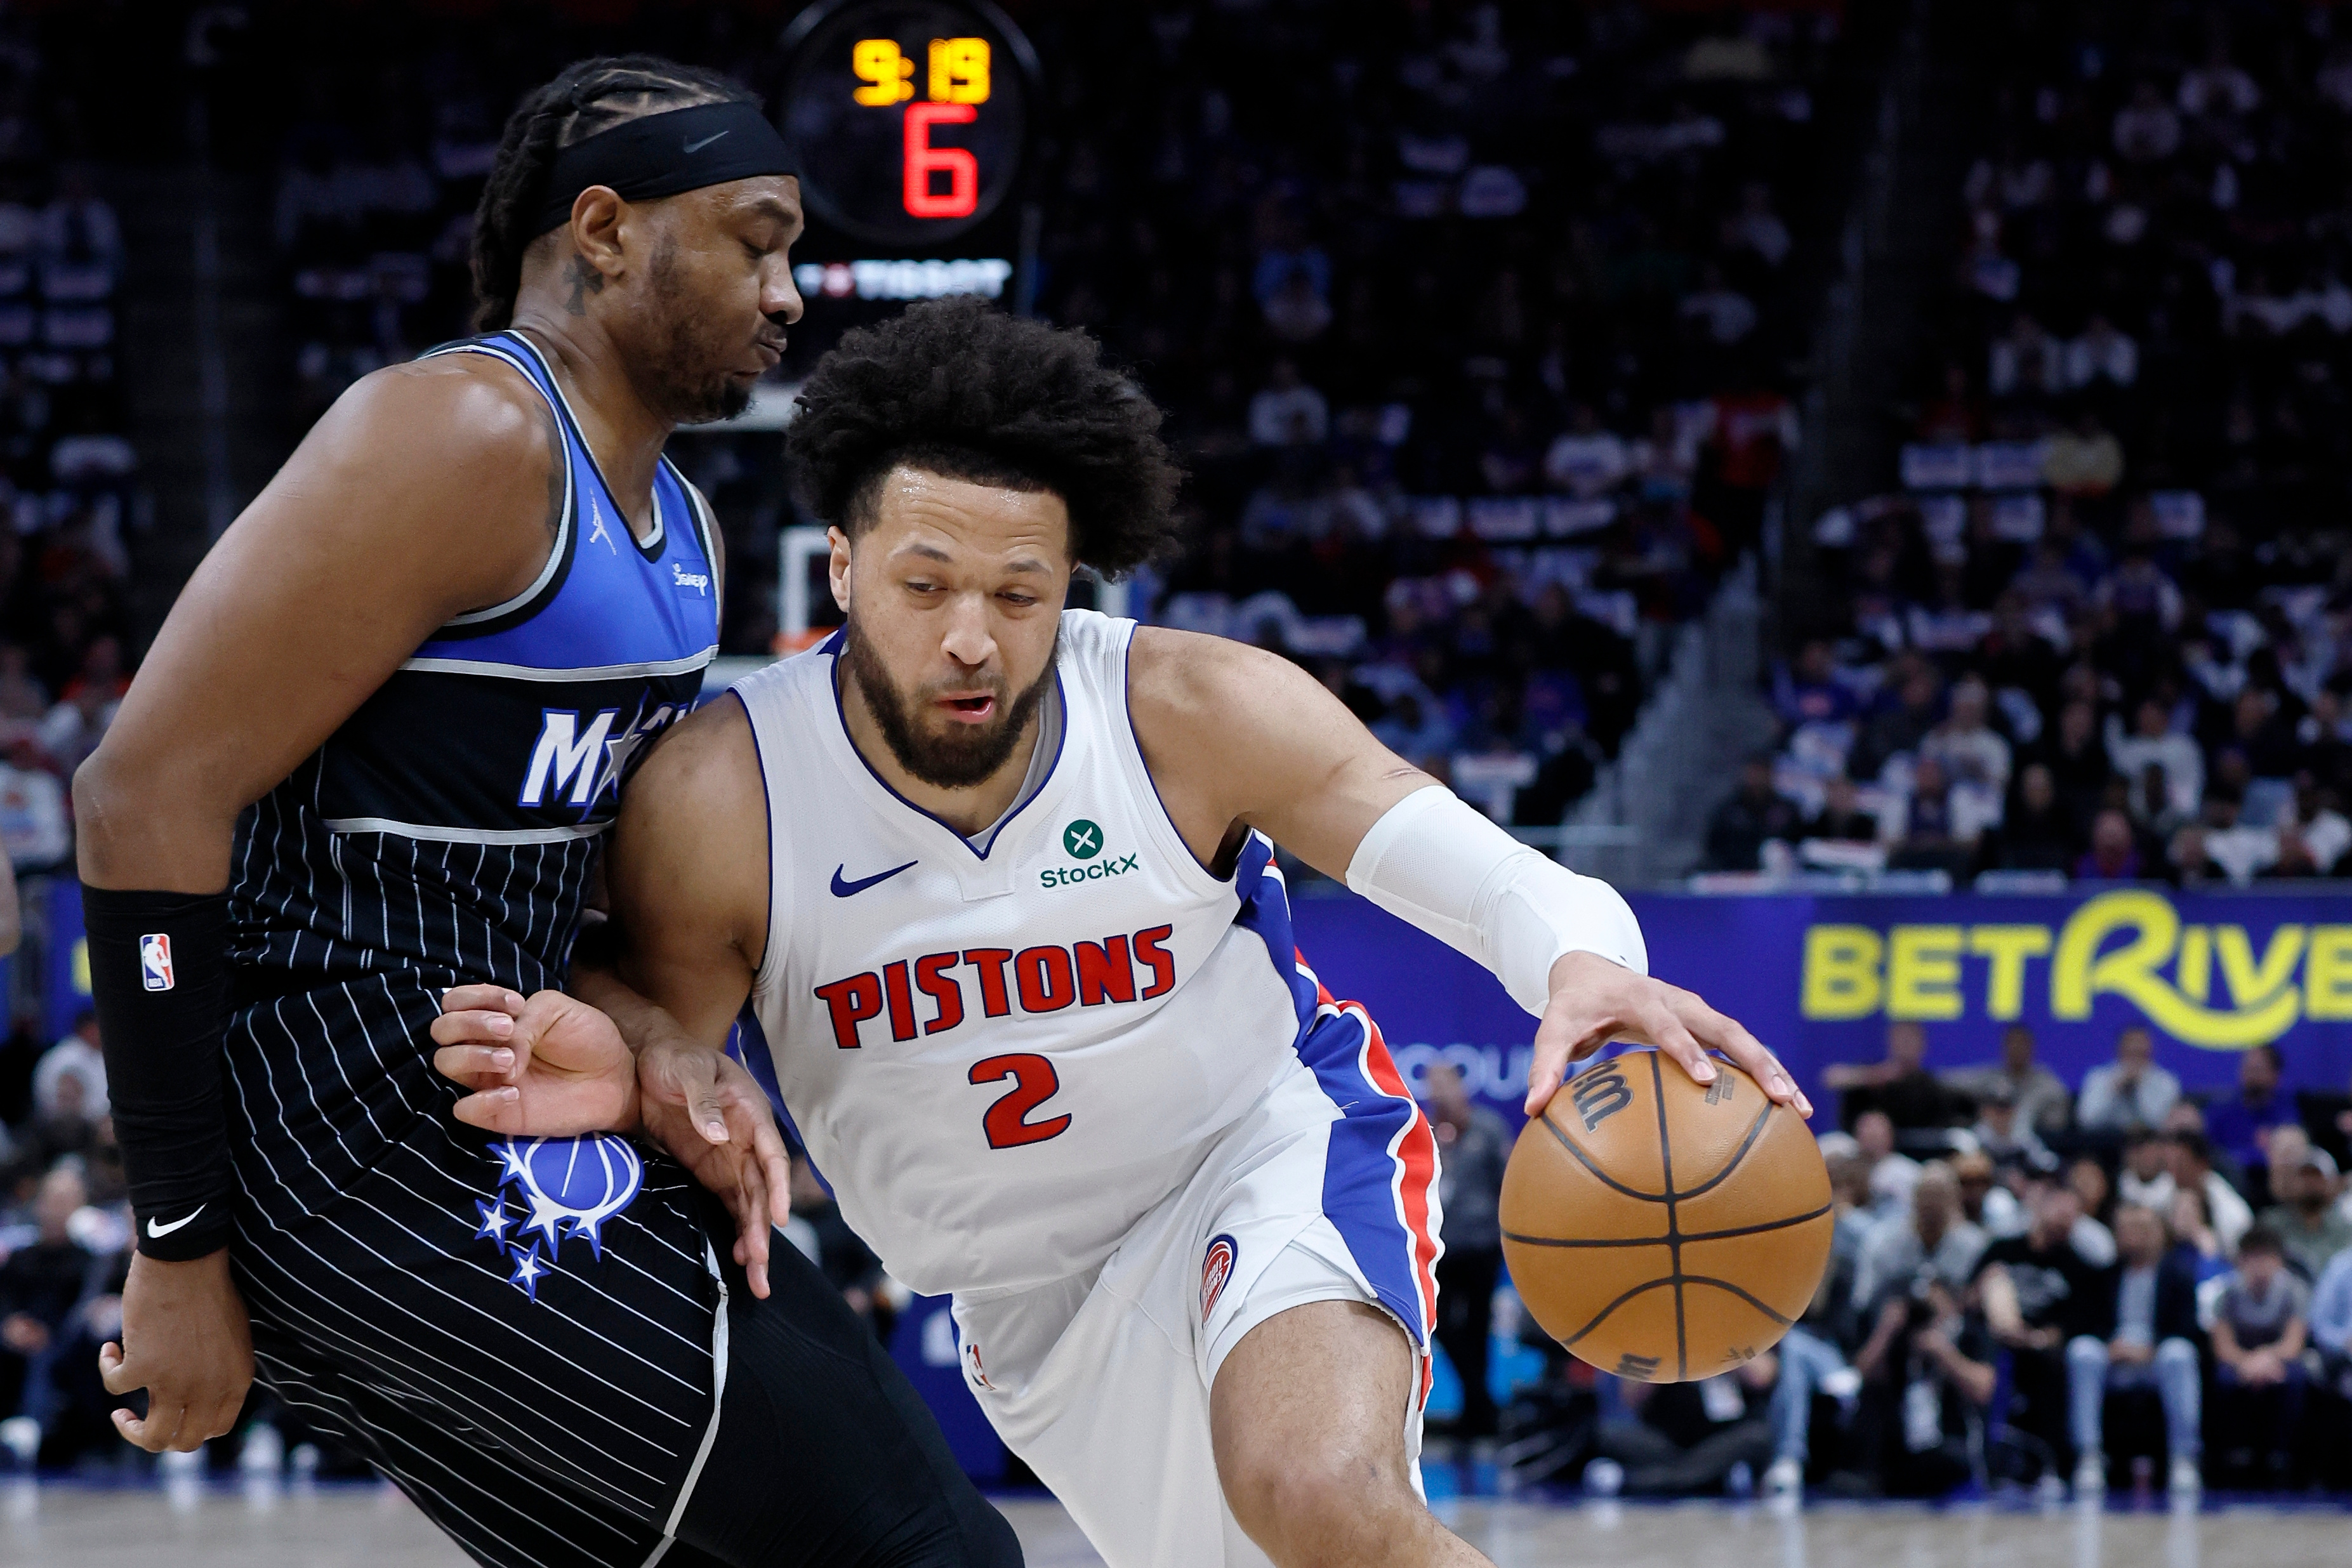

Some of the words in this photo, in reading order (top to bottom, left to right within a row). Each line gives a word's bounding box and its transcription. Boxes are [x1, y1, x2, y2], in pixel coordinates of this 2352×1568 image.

[903, 102, 978, 218] 6
[1040, 852, 1139, 888] StockX
[814, 924, 1176, 1050] PISTONS
[968, 1053, 1072, 1150] 2
